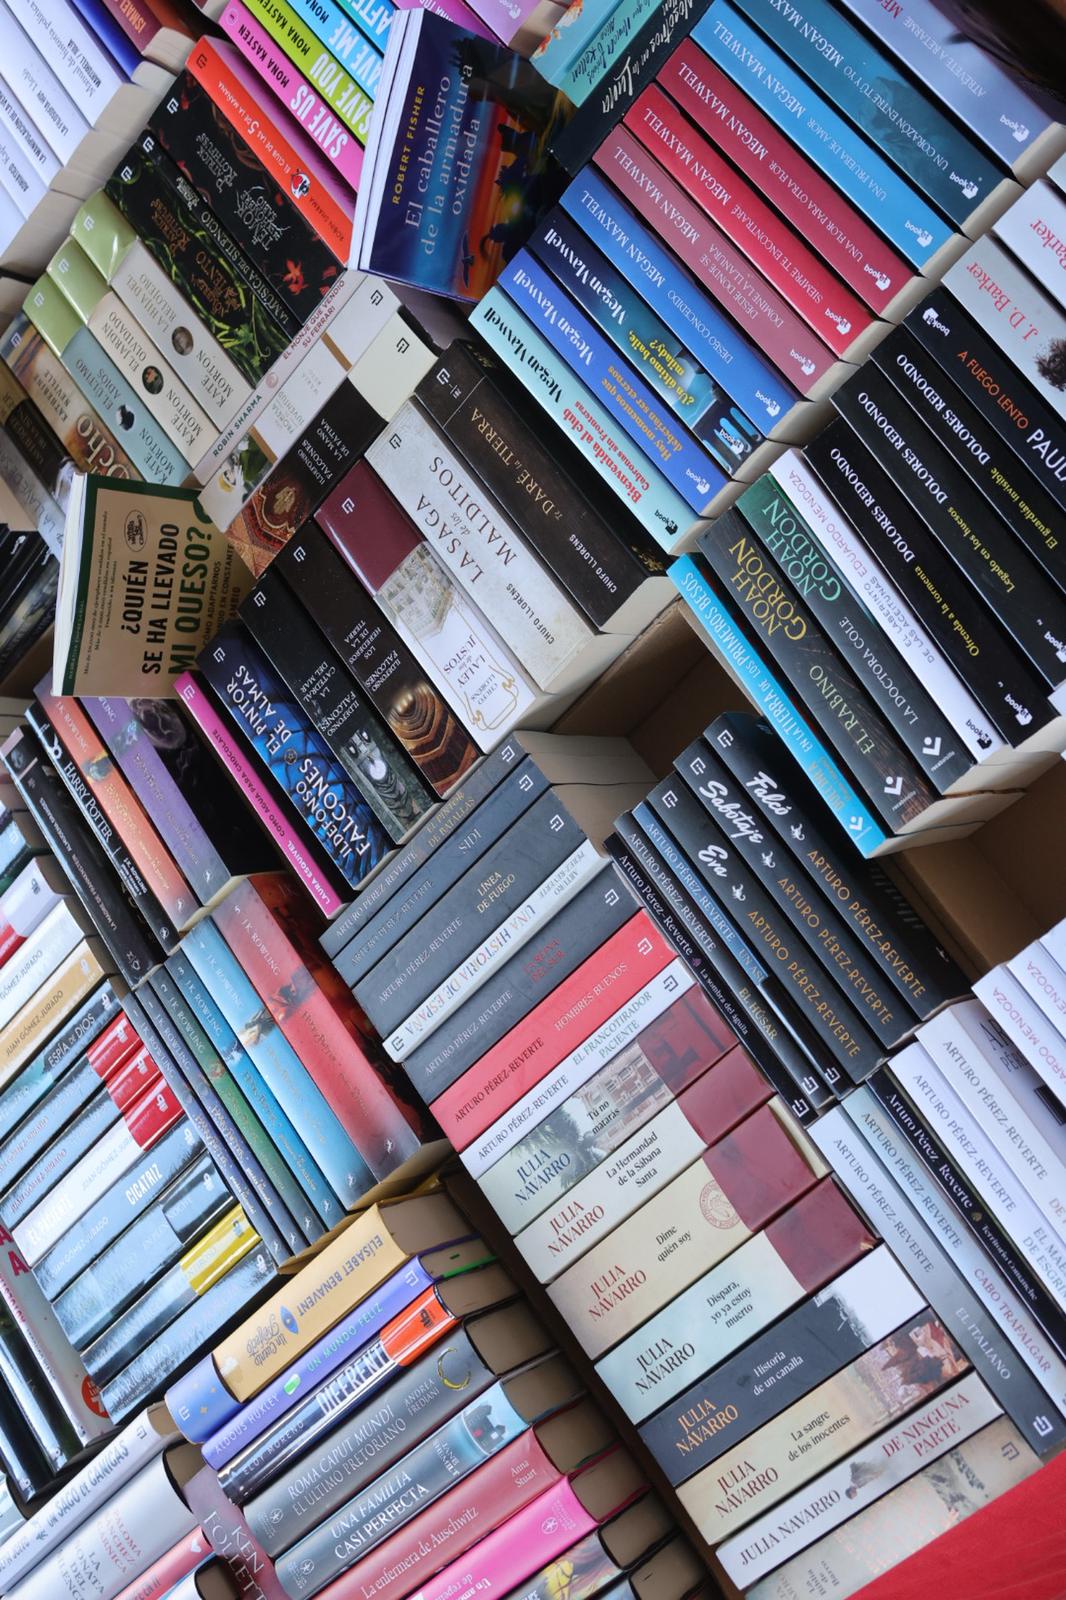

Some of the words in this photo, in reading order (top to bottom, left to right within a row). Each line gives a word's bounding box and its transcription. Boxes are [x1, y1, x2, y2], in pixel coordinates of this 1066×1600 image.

[26, 0, 52, 30] política
[44, 27, 69, 57] historia
[64, 55, 76, 68] de
[234, 24, 269, 61] KASTEN
[797, 19, 846, 68] MEGAN
[71, 66, 96, 96] Manual
[213, 80, 240, 110] MAÑANA
[263, 57, 292, 88] MONA
[672, 60, 731, 120] MAXWELL
[235, 107, 246, 117] LA
[241, 114, 252, 124] DE
[244, 118, 261, 134] 5
[283, 83, 321, 120] US
[254, 131, 267, 143] LAS
[262, 140, 273, 151] DE
[302, 106, 353, 158] SAVE
[392, 145, 410, 205] ROBERT
[409, 86, 425, 139] FISHER
[405, 201, 424, 228] El
[417, 76, 450, 193] caballero
[638, 106, 696, 164] MAXWELL
[722, 114, 769, 161] MEGAN
[805, 115, 834, 142] AMOR
[827, 138, 843, 152] DE
[269, 148, 286, 166] CLUB
[281, 163, 291, 172] EL
[453, 118, 481, 216] oxidada
[607, 145, 665, 205] MAXWELL
[766, 158, 792, 182] FLOR
[837, 148, 872, 183] PRUEBA
[686, 159, 733, 207] MEGAN
[785, 177, 811, 204] OTRA
[865, 179, 888, 201] UNA
[574, 189, 631, 247] MAXWELL
[656, 199, 701, 245] MEGAN
[804, 199, 830, 224] PARA
[824, 220, 849, 244] FLOR
[541, 227, 593, 282] Maxwell
[622, 241, 667, 288] MEGAN
[842, 241, 865, 262] UNA
[510, 269, 562, 322] Maxwell
[584, 275, 631, 325] Megan
[480, 306, 529, 360] Maxwell
[552, 316, 599, 366] Megan
[193, 348, 234, 398] MORTON
[198, 374, 226, 407] KATE
[521, 354, 568, 403] Megan
[892, 352, 947, 412] REDONDO
[163, 388, 204, 437] MORTON
[168, 414, 196, 447] KATE
[211, 427, 235, 457] ROBIN
[233, 391, 263, 431] SHARMA
[557, 408, 584, 433] club
[569, 400, 608, 441] Fronteras
[854, 390, 907, 450] REDONDO
[938, 408, 991, 466] DOLORES
[136, 426, 176, 475] MORTON
[298, 439, 333, 480] FALCONES
[576, 429, 594, 446] al
[602, 438, 618, 455] sin
[586, 441, 643, 503] Bienvenida
[613, 451, 651, 492] Cabronas
[785, 469, 829, 523] MENDOZA
[827, 445, 876, 508] REDONDO
[898, 446, 949, 505] DOLORES
[408, 493, 462, 555] SAGA
[424, 454, 517, 566] MALDITOS
[868, 504, 916, 563] DOLORES
[152, 523, 179, 610] LLEVADO
[453, 551, 484, 582] LA
[760, 497, 844, 604] GORDON
[763, 529, 817, 595] NOAH
[823, 521, 868, 578] EDUARDO
[120, 560, 149, 634] ¿QUIÉN
[175, 526, 212, 633] QUESO?
[726, 535, 811, 643] GORDON
[728, 568, 782, 634] NOAH
[147, 618, 168, 643] HA
[343, 619, 365, 644] TIERRA
[348, 626, 381, 664] HEREDEROS
[836, 616, 865, 651] COLE
[142, 651, 163, 674] SE
[168, 645, 196, 674] MI
[363, 649, 398, 688] FALCONES
[858, 647, 906, 708] DOCTORA
[223, 678, 268, 735] PINTOR
[232, 663, 276, 719] ALMAS
[806, 662, 860, 730] RABINO
[899, 704, 919, 725] LA
[262, 734, 281, 754] EL
[270, 718, 292, 743] DE
[851, 727, 877, 755] EL
[292, 778, 353, 858] ILDEFONSO
[295, 756, 372, 855] FALCONES
[743, 770, 796, 819] Falcó
[696, 839, 740, 880] Eva
[476, 896, 491, 913] DE
[487, 872, 516, 901] FUEGO
[627, 830, 664, 876] ARTURO
[657, 871, 719, 952] PÉREZ-REVERTE
[806, 846, 854, 902] ARTURO
[846, 898, 928, 998] PÉREZ-REVERTE
[775, 874, 822, 930] ARTURO
[815, 926, 896, 1025] PÉREZ-REVERTE
[746, 907, 792, 962] ARTURO
[785, 958, 863, 1057] PÉREZ-REVERTE
[737, 986, 754, 1004] EL
[748, 999, 781, 1040] HÚSAR
[45, 1038, 69, 1067] ESPÍA
[72, 1010, 95, 1038] DIOS
[452, 1088, 485, 1122] ARTURO
[480, 1035, 544, 1094] PÉREZ-REVERTE
[475, 1126, 509, 1160] ARTURO
[504, 1073, 569, 1131] PÉREZ-REVERTE
[123, 1161, 163, 1205] CICATRIZ
[513, 1151, 572, 1206] NAVARRO
[518, 1148, 551, 1183] JULIA
[860, 1109, 901, 1159] ARTURO
[893, 1154, 966, 1249] PÉREZ-REVERTE
[550, 1199, 584, 1235] JULIA
[832, 1135, 872, 1184] ARTURO
[866, 1180, 937, 1273] PÉREZ-REVERTE
[548, 1204, 606, 1257] NAVARRO
[339, 1233, 385, 1278] ELÍSABET
[294, 1269, 344, 1317] BENAVENT
[592, 1262, 626, 1299] JULIA
[971, 1266, 1003, 1303] CABO
[996, 1300, 1053, 1372] TRAFALGAR
[635, 1341, 697, 1395] NAVARRO
[637, 1335, 673, 1372] JULIA
[211, 1419, 248, 1453] ALDOUS
[246, 1391, 280, 1424] HUXLEY
[675, 1403, 740, 1457] NAVARRO
[678, 1396, 717, 1433] JULIA
[786, 1448, 800, 1462] de
[796, 1439, 811, 1454] los
[808, 1412, 850, 1446] inocentes
[790, 1428, 803, 1441] La
[801, 1409, 832, 1436] sangre
[881, 1434, 906, 1458] DE
[901, 1389, 969, 1443] NINGUNA
[912, 1418, 960, 1457] PARTE
[327, 1508, 360, 1538] UNA
[355, 1469, 412, 1517] FAMILIA
[332, 1527, 366, 1559] CASI
[361, 1479, 429, 1536] PERFECTA
[229, 1524, 266, 1573] KEN
[359, 1580, 376, 1598] La
[372, 1548, 420, 1589] enfermera
[416, 1540, 432, 1556] de
[427, 1504, 479, 1548] Auschwitz
